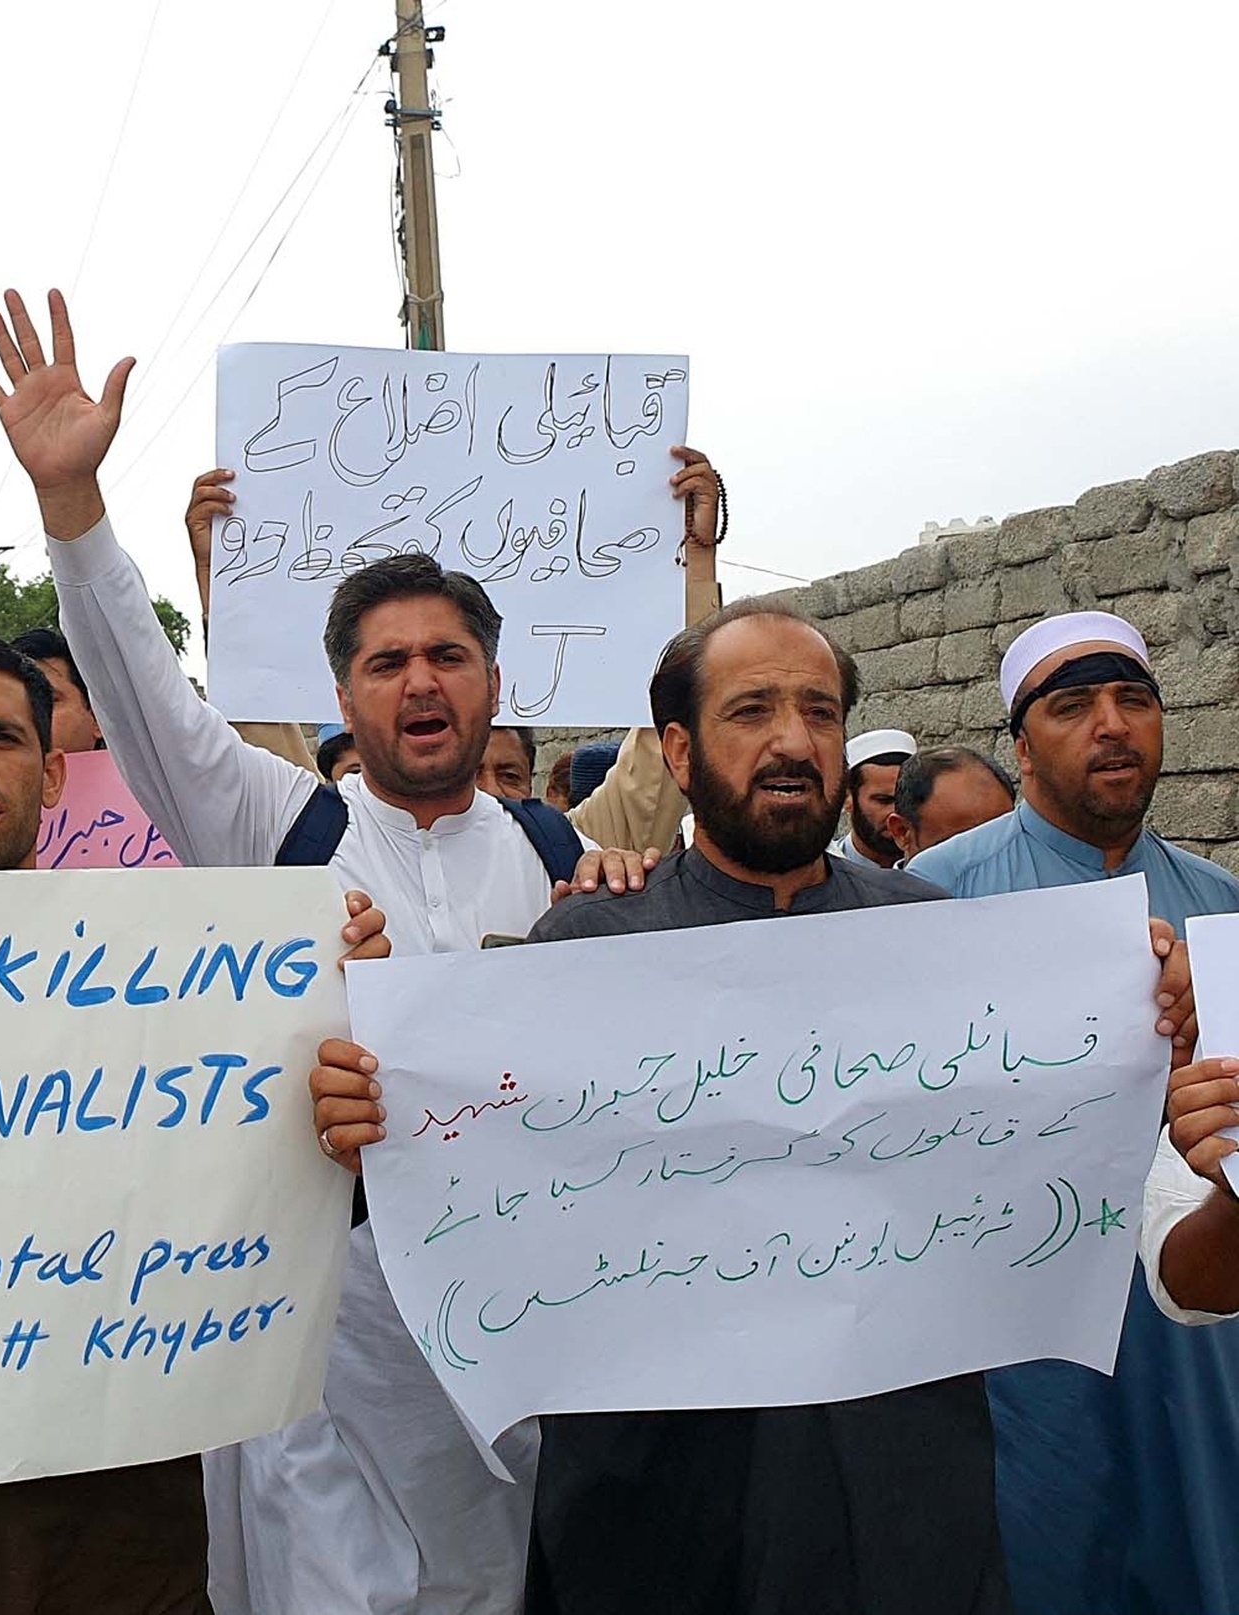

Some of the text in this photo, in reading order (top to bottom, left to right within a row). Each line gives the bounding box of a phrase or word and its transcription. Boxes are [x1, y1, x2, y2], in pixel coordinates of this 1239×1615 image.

[521, 1053, 677, 1132] جبران
[656, 1036, 758, 1123] خلیل
[778, 1030, 916, 1105] صحافی
